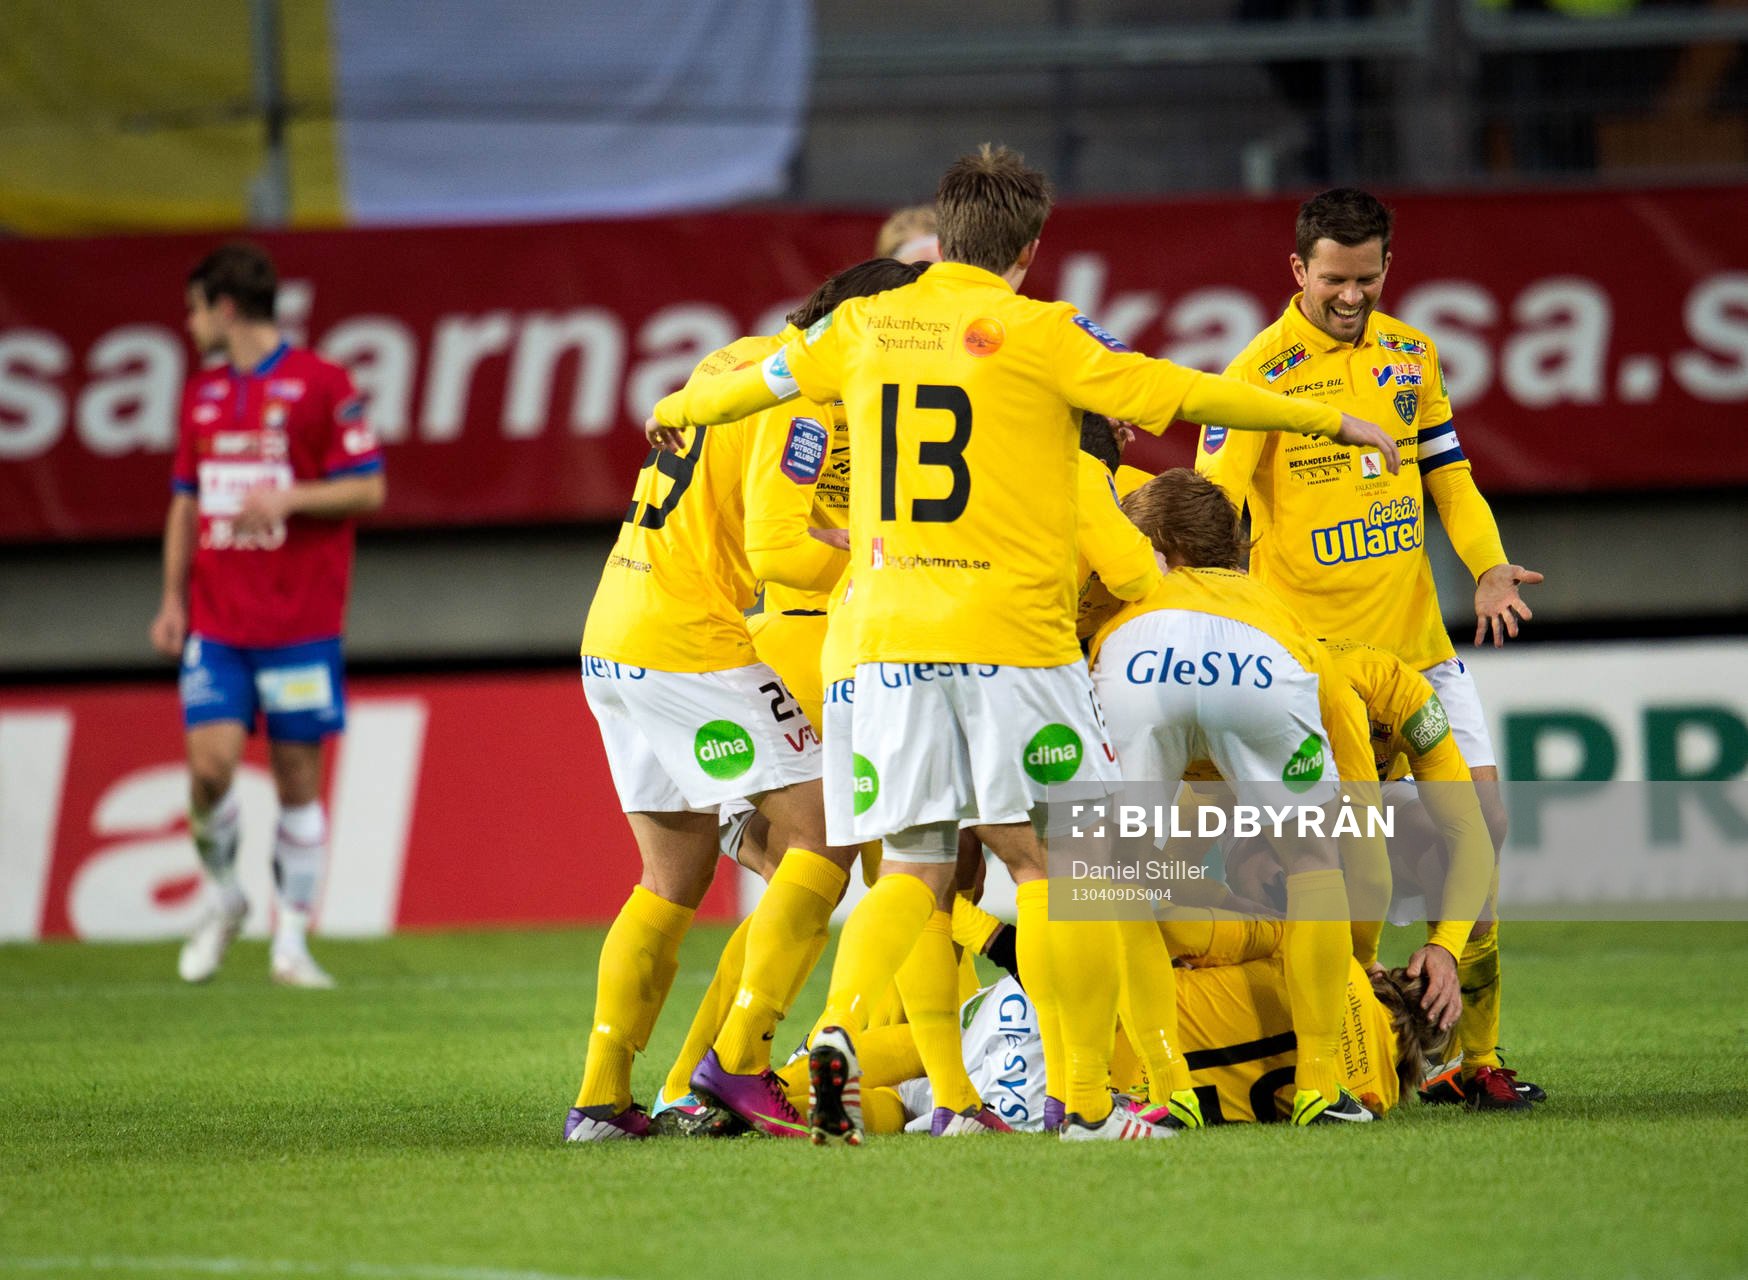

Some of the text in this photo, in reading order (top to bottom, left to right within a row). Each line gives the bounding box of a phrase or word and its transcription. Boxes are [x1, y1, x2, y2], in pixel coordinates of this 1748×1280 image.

[867, 315, 951, 336] Falkenbergs
[876, 333, 945, 352] Sparbank
[1281, 378, 1344, 397] OVEKS BIL
[793, 435, 823, 452] SVERIGES
[801, 431, 819, 442] HELA
[790, 442, 822, 459] FOTBOLLS
[794, 451, 815, 464] KLUBB
[881, 383, 973, 523] 13
[1289, 455, 1332, 468] BERANDERS
[1368, 496, 1418, 528] Gekås
[1127, 647, 1273, 690] GleSYS
[1413, 715, 1437, 739] CASH
[698, 737, 748, 762] dina
[1028, 742, 1077, 766] dina
[1287, 750, 1323, 776] dina
[997, 993, 1031, 1122] GleSYS
